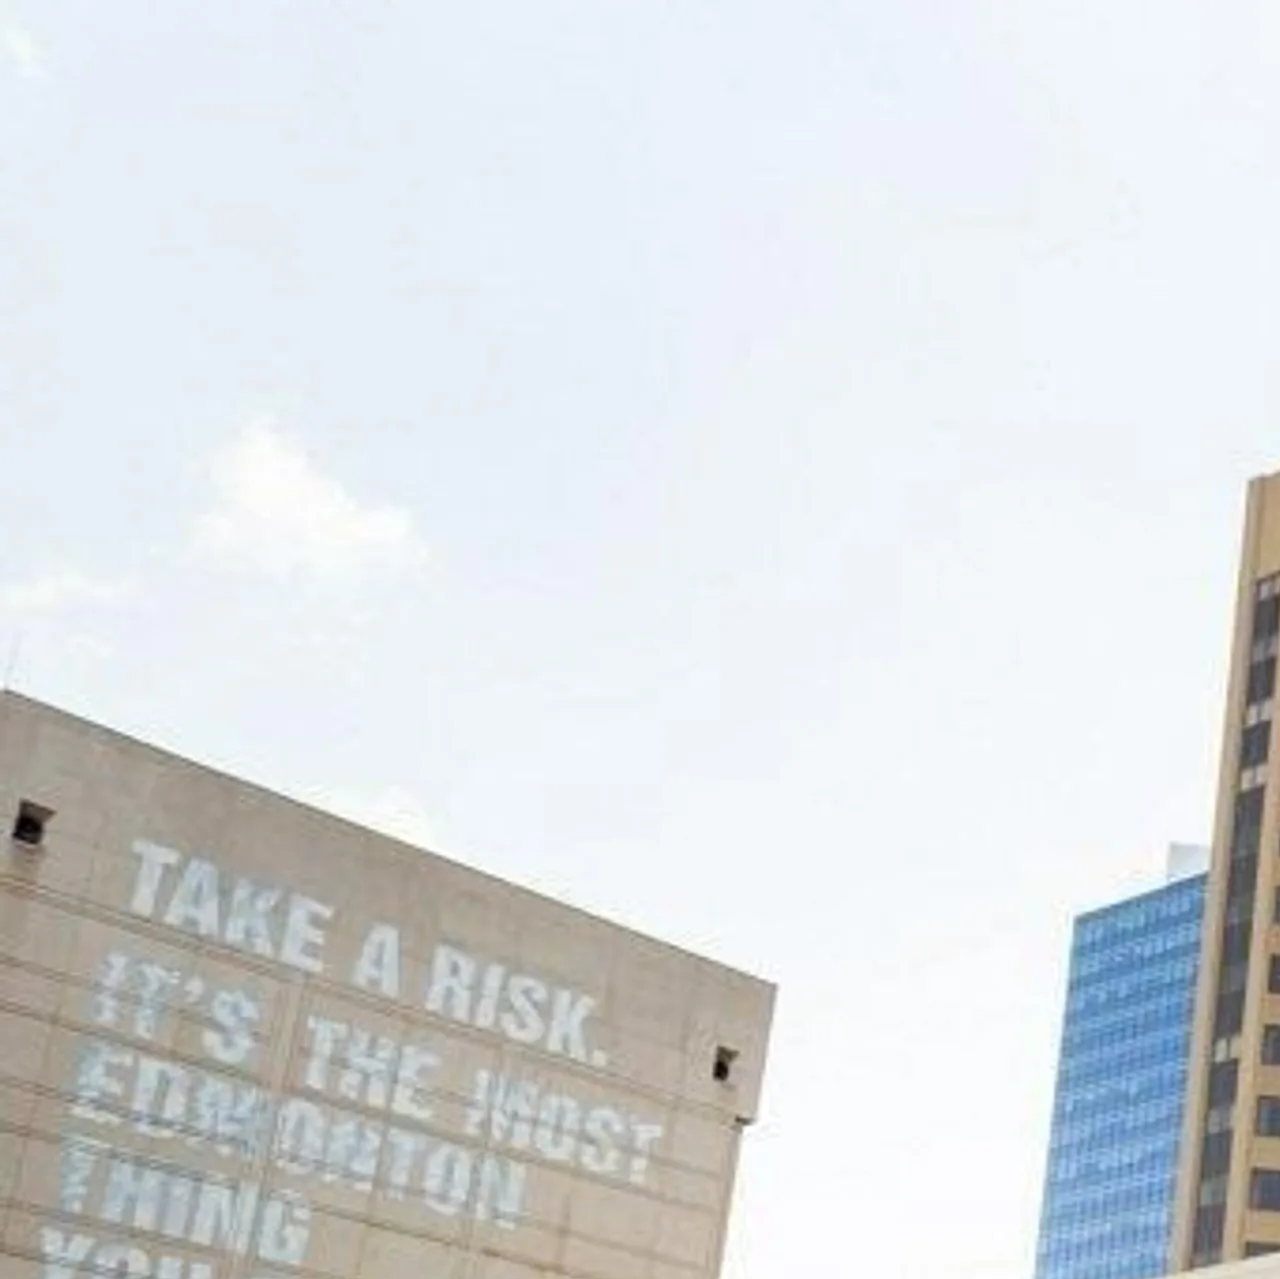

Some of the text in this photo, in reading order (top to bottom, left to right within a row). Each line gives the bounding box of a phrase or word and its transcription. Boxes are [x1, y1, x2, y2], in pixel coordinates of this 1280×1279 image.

[131, 838, 608, 1067] TAKE A RISK.
[95, 951, 664, 1186] IT'S THE MOST
[60, 1133, 311, 1266] THING
